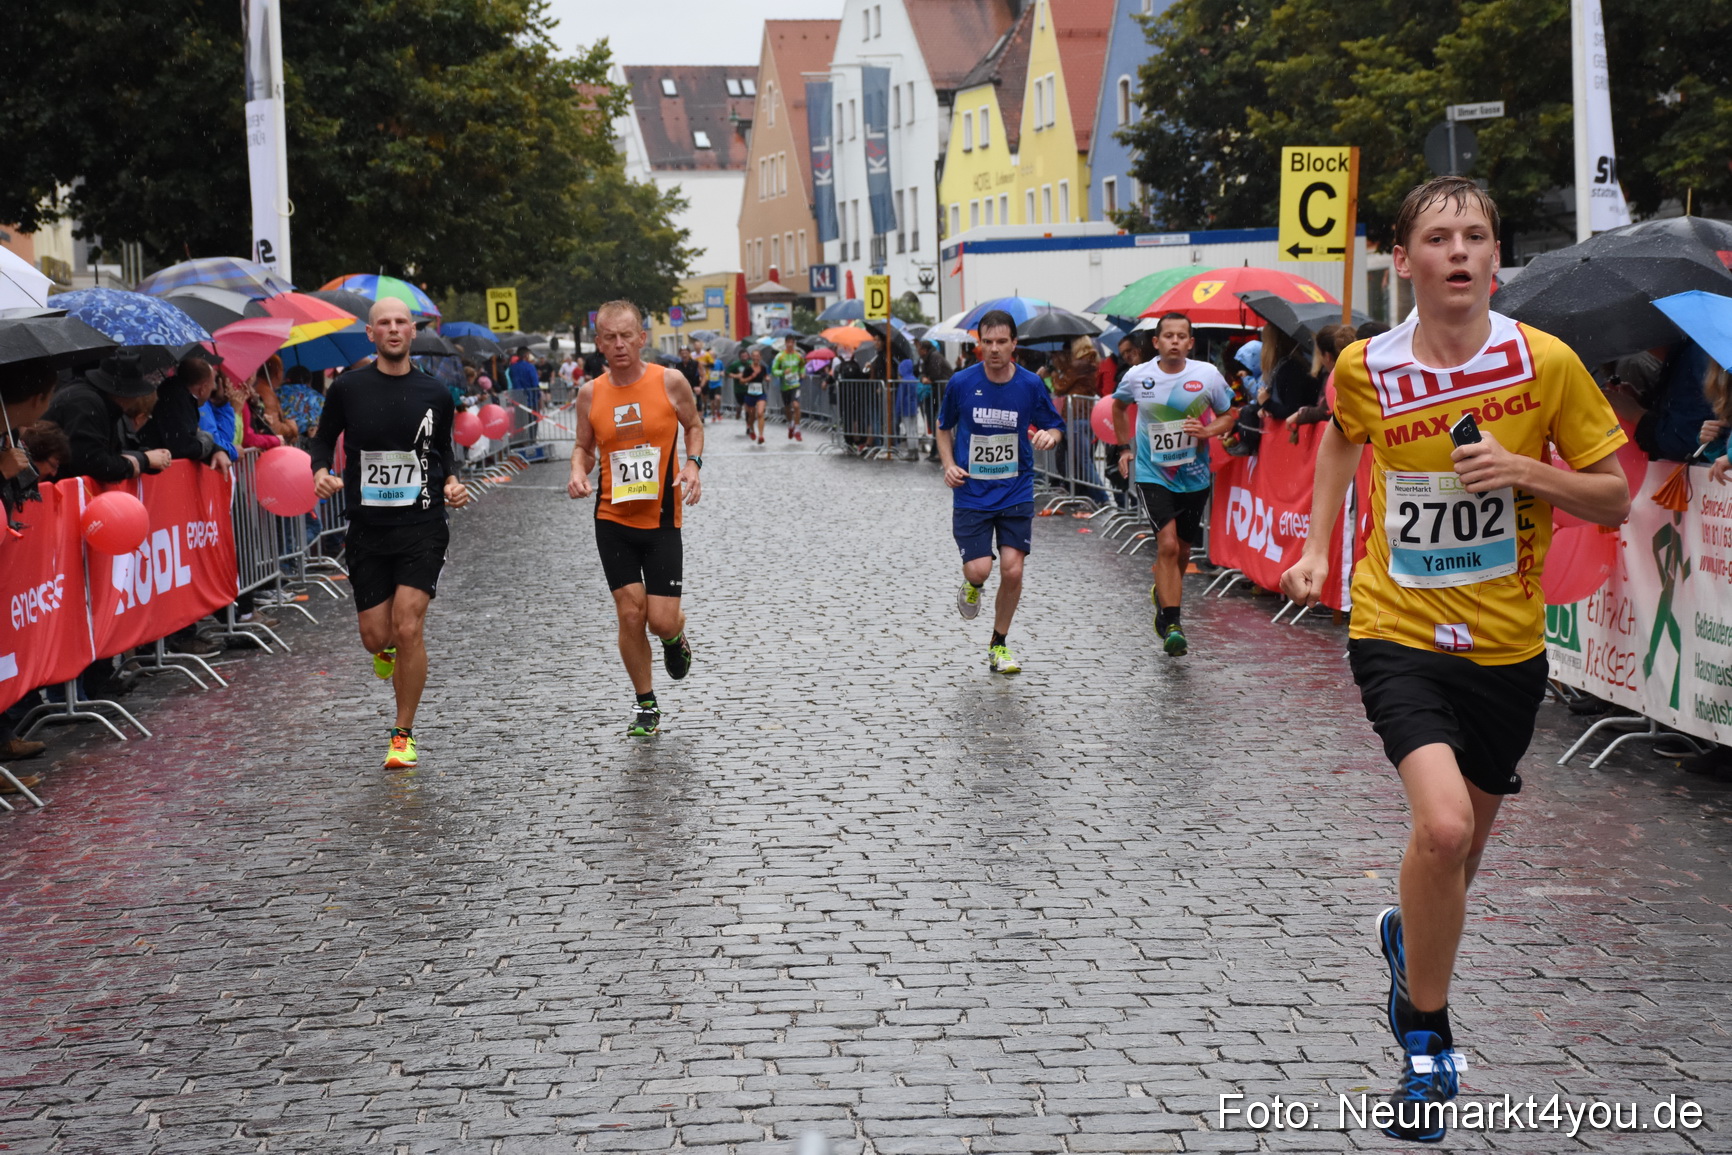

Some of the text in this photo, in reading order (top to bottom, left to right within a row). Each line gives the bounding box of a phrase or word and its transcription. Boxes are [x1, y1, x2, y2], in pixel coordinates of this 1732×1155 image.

[1291, 152, 1349, 172] Block
[1298, 182, 1337, 237] C
[871, 289, 884, 309] D
[495, 301, 510, 322] D
[973, 407, 1019, 422] HUBER
[1384, 391, 1541, 448] MAX BÖGL
[974, 444, 1014, 463] 2525
[1162, 451, 1188, 461] Rüdiger
[367, 464, 416, 485] 2577
[619, 460, 653, 483] 218
[979, 465, 1010, 474] Christoph
[378, 490, 405, 499] Tobias
[627, 483, 647, 494] Ralph
[1394, 485, 1432, 493] NeuerMarkt
[1399, 496, 1505, 545] 2702
[1423, 551, 1482, 573] Yannik
